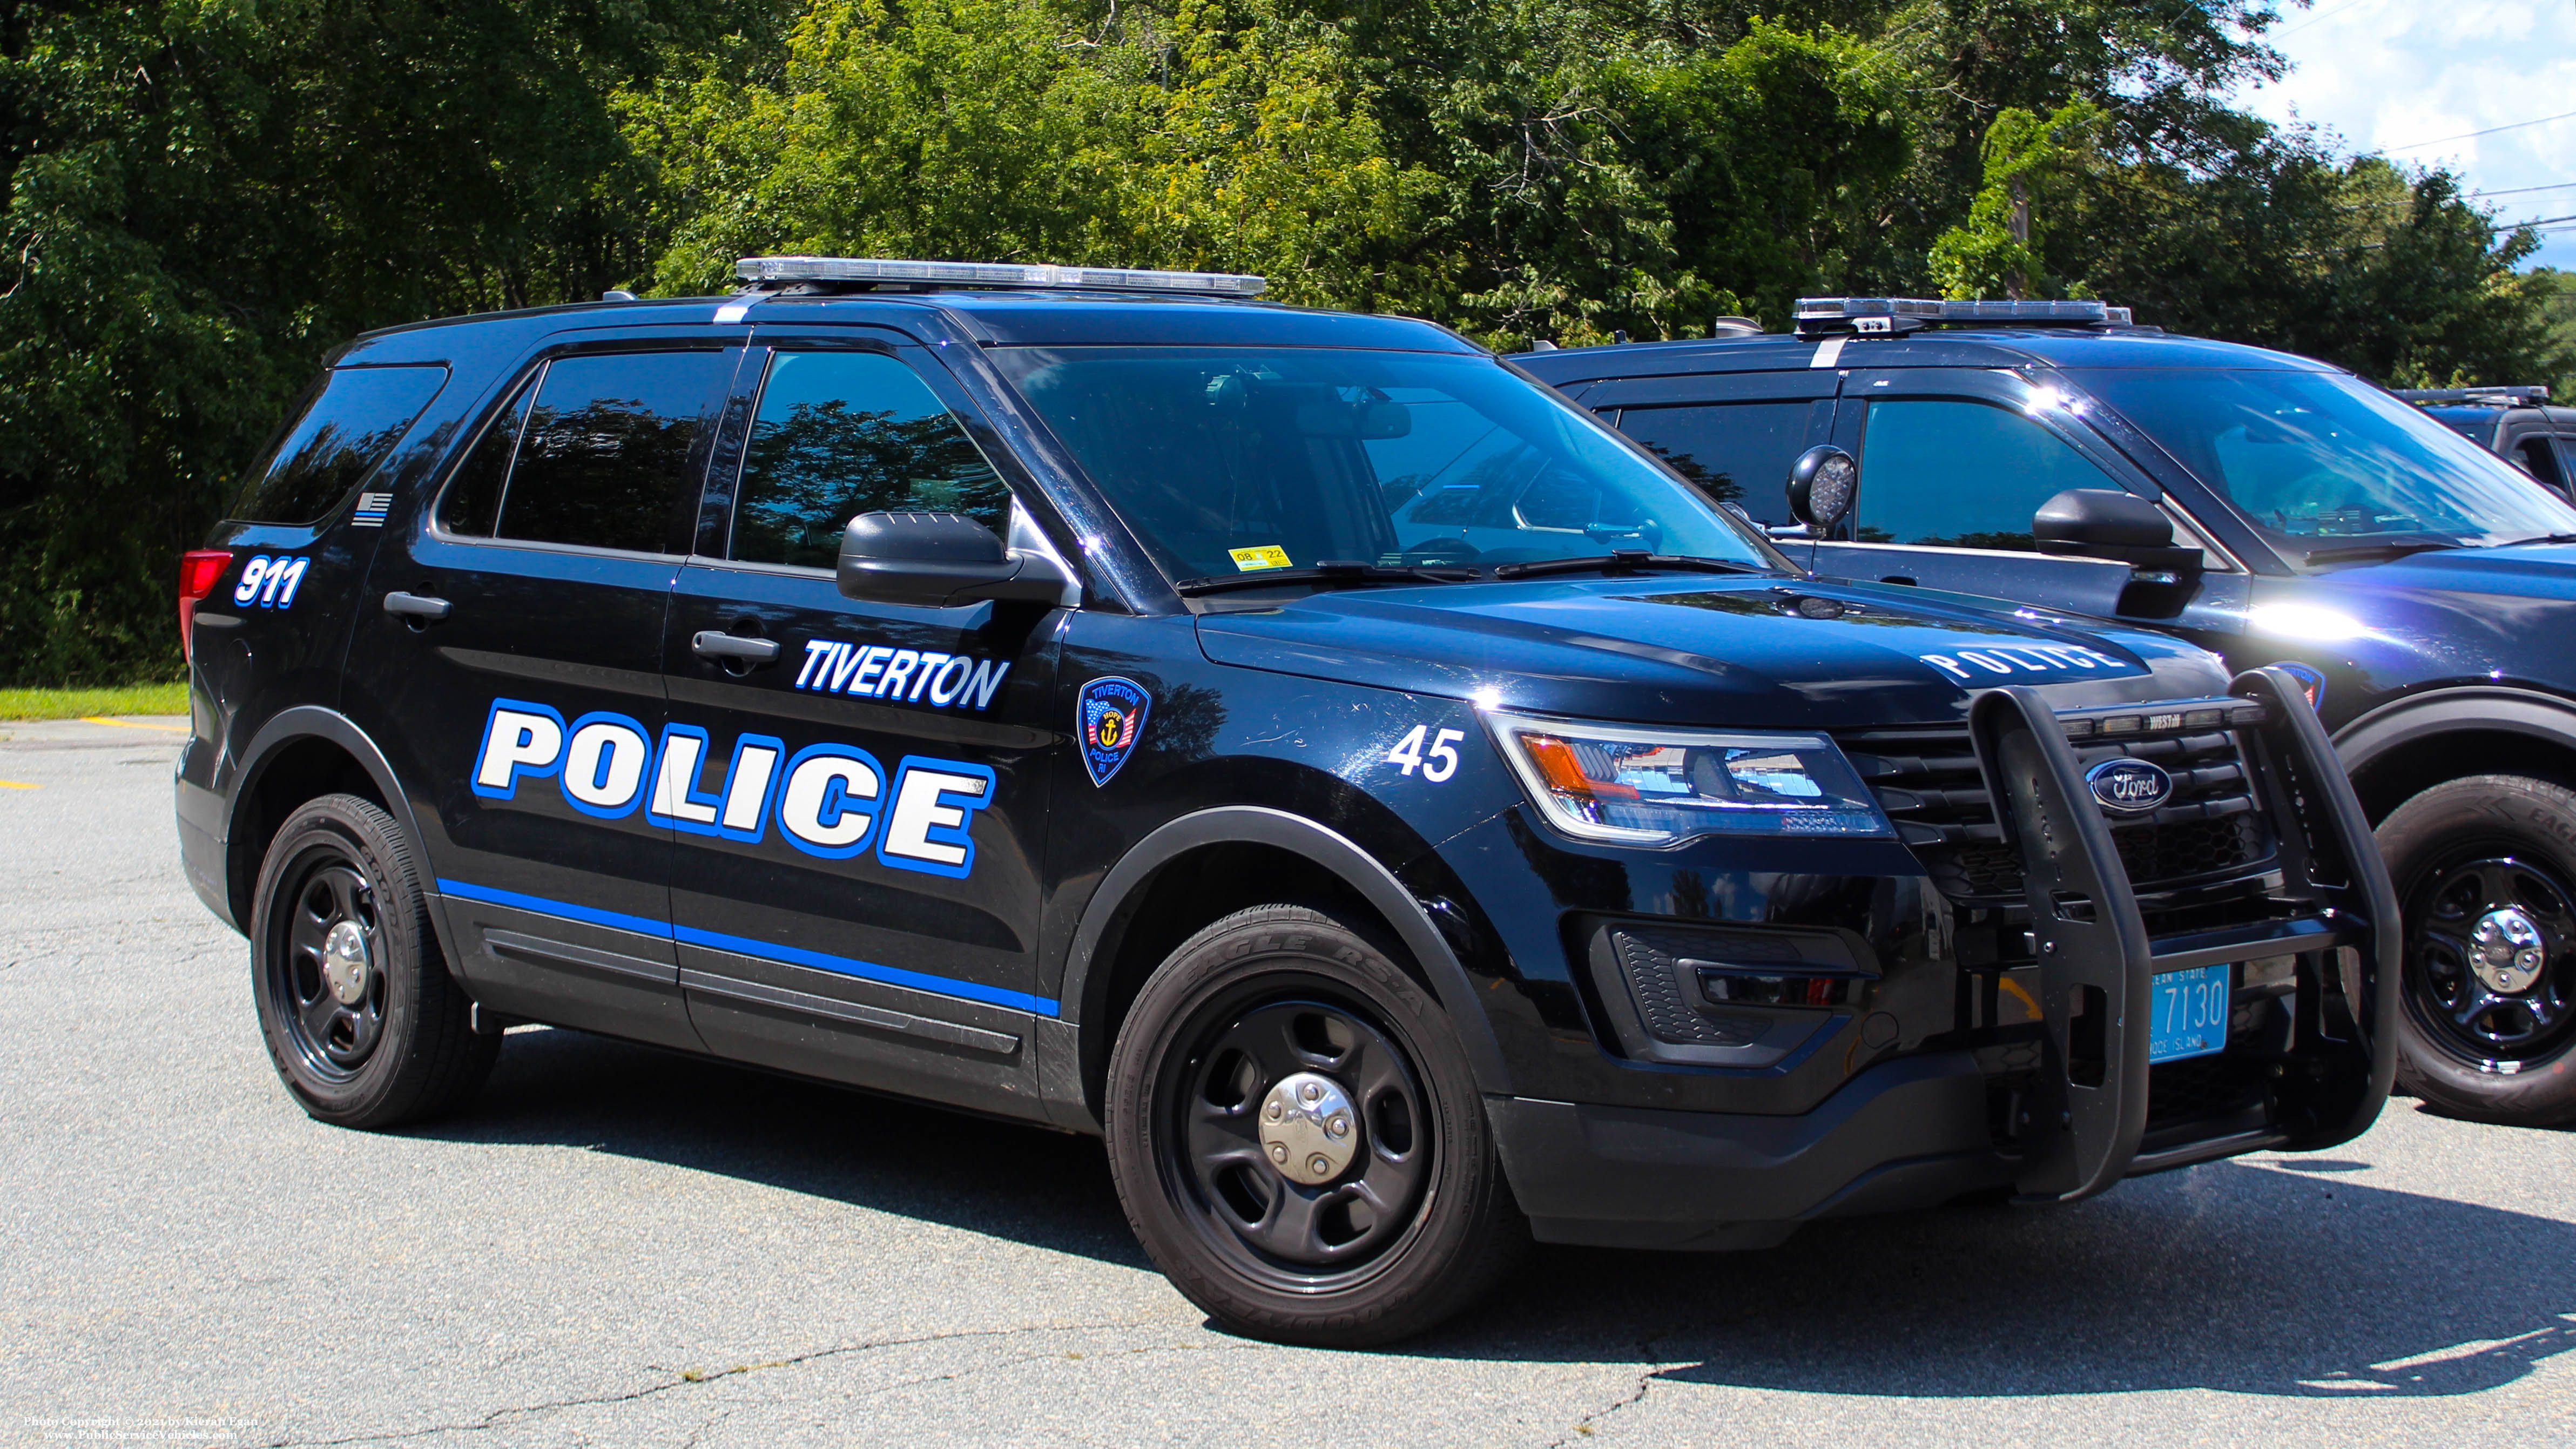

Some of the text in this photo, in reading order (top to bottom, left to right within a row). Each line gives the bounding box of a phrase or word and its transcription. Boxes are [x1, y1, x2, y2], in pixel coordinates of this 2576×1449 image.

[1266, 550, 1283, 558] 22
[234, 555, 310, 609] 911
[795, 639, 1010, 709] TIVERTON
[1919, 646, 2126, 678] POLICE
[1092, 684, 1140, 706] TIVERTON
[1103, 711, 1121, 722] HOPE
[1090, 748, 1119, 763] POLICE
[1097, 763, 1106, 773] RI
[1387, 724, 1465, 783] 45
[471, 698, 995, 879] POLICE
[2113, 767, 2159, 799] Ford
[1186, 934, 1313, 985] EAGLE
[2179, 967, 2207, 982] STATE
[2165, 980, 2223, 1033] 7130
[2173, 1034, 2202, 1050] ISLAND
